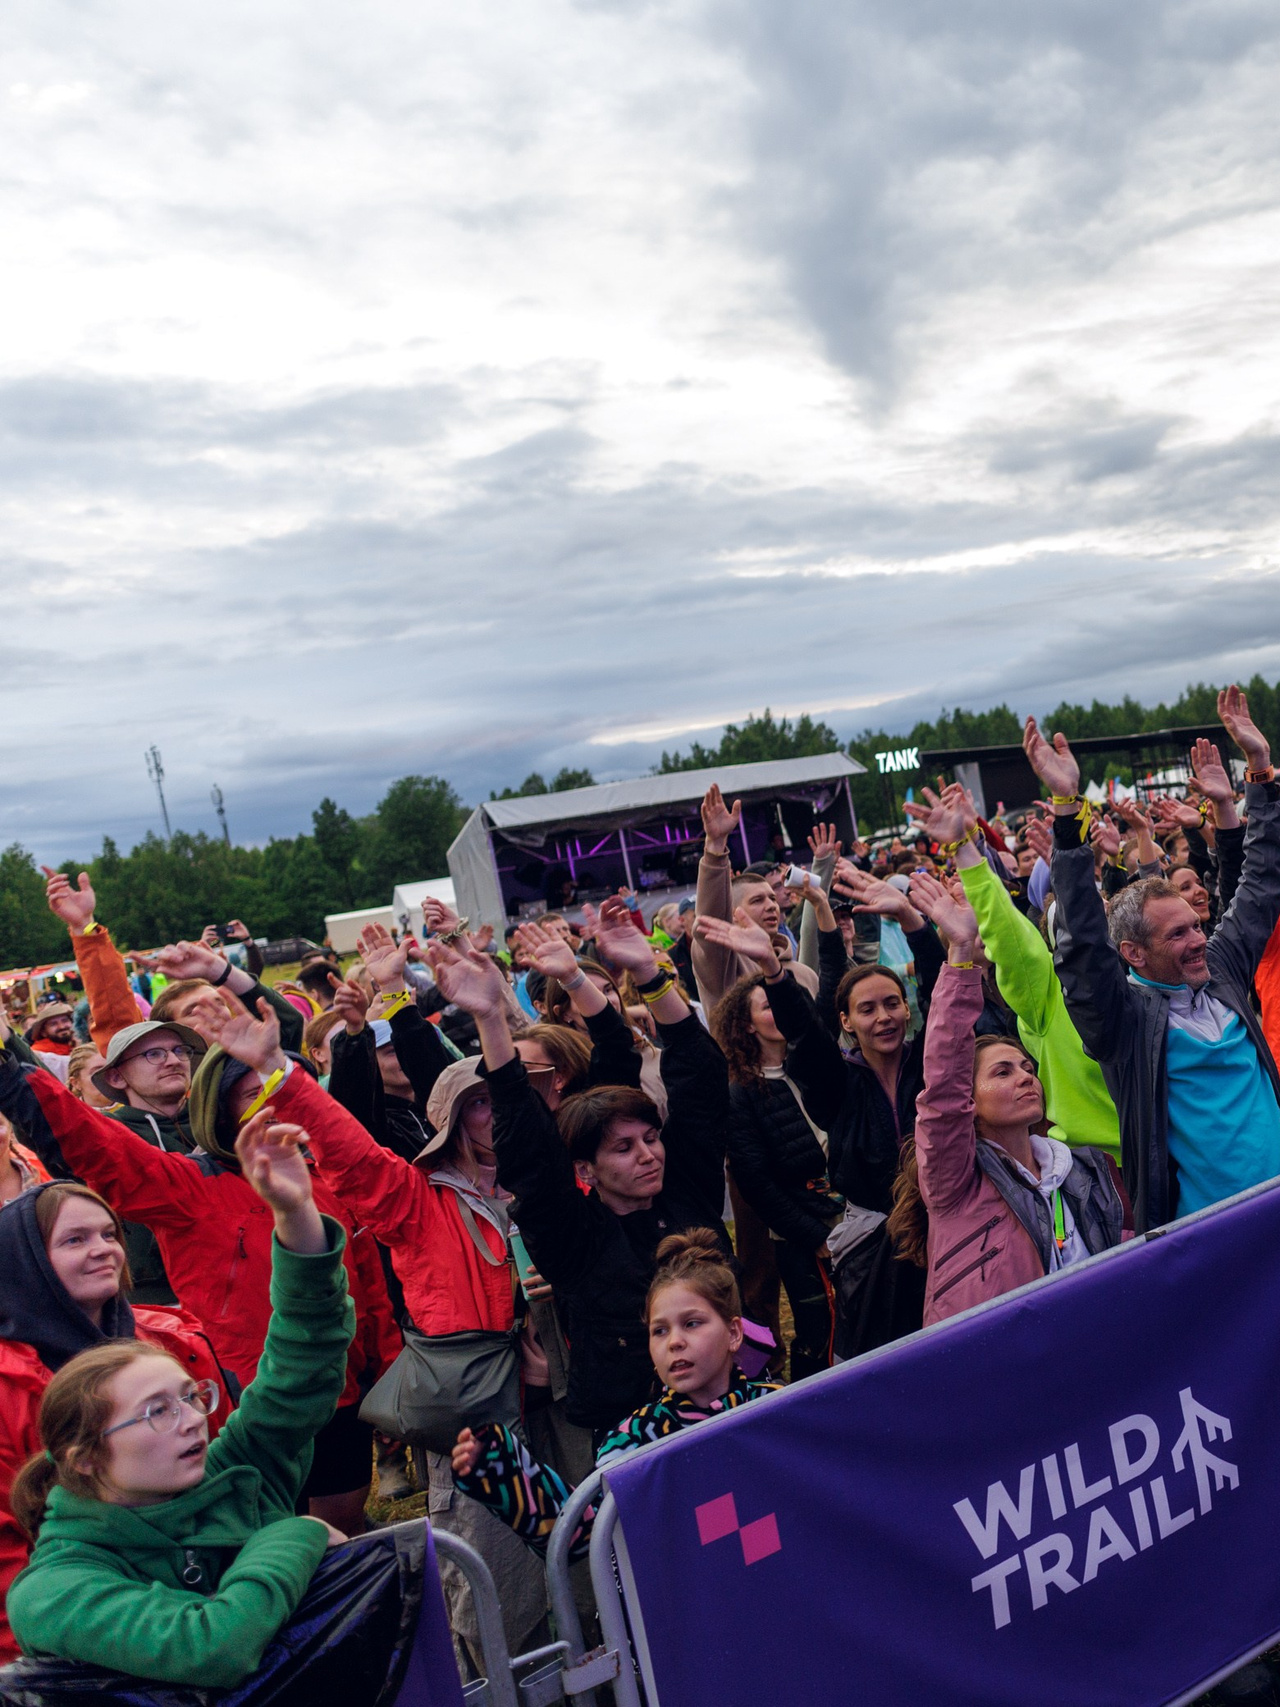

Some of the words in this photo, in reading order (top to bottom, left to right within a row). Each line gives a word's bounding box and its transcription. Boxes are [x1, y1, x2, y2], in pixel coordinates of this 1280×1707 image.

[875, 746, 920, 774] TANK
[952, 1414, 1160, 1560] WILD
[971, 1476, 1195, 1629] TRAIL
